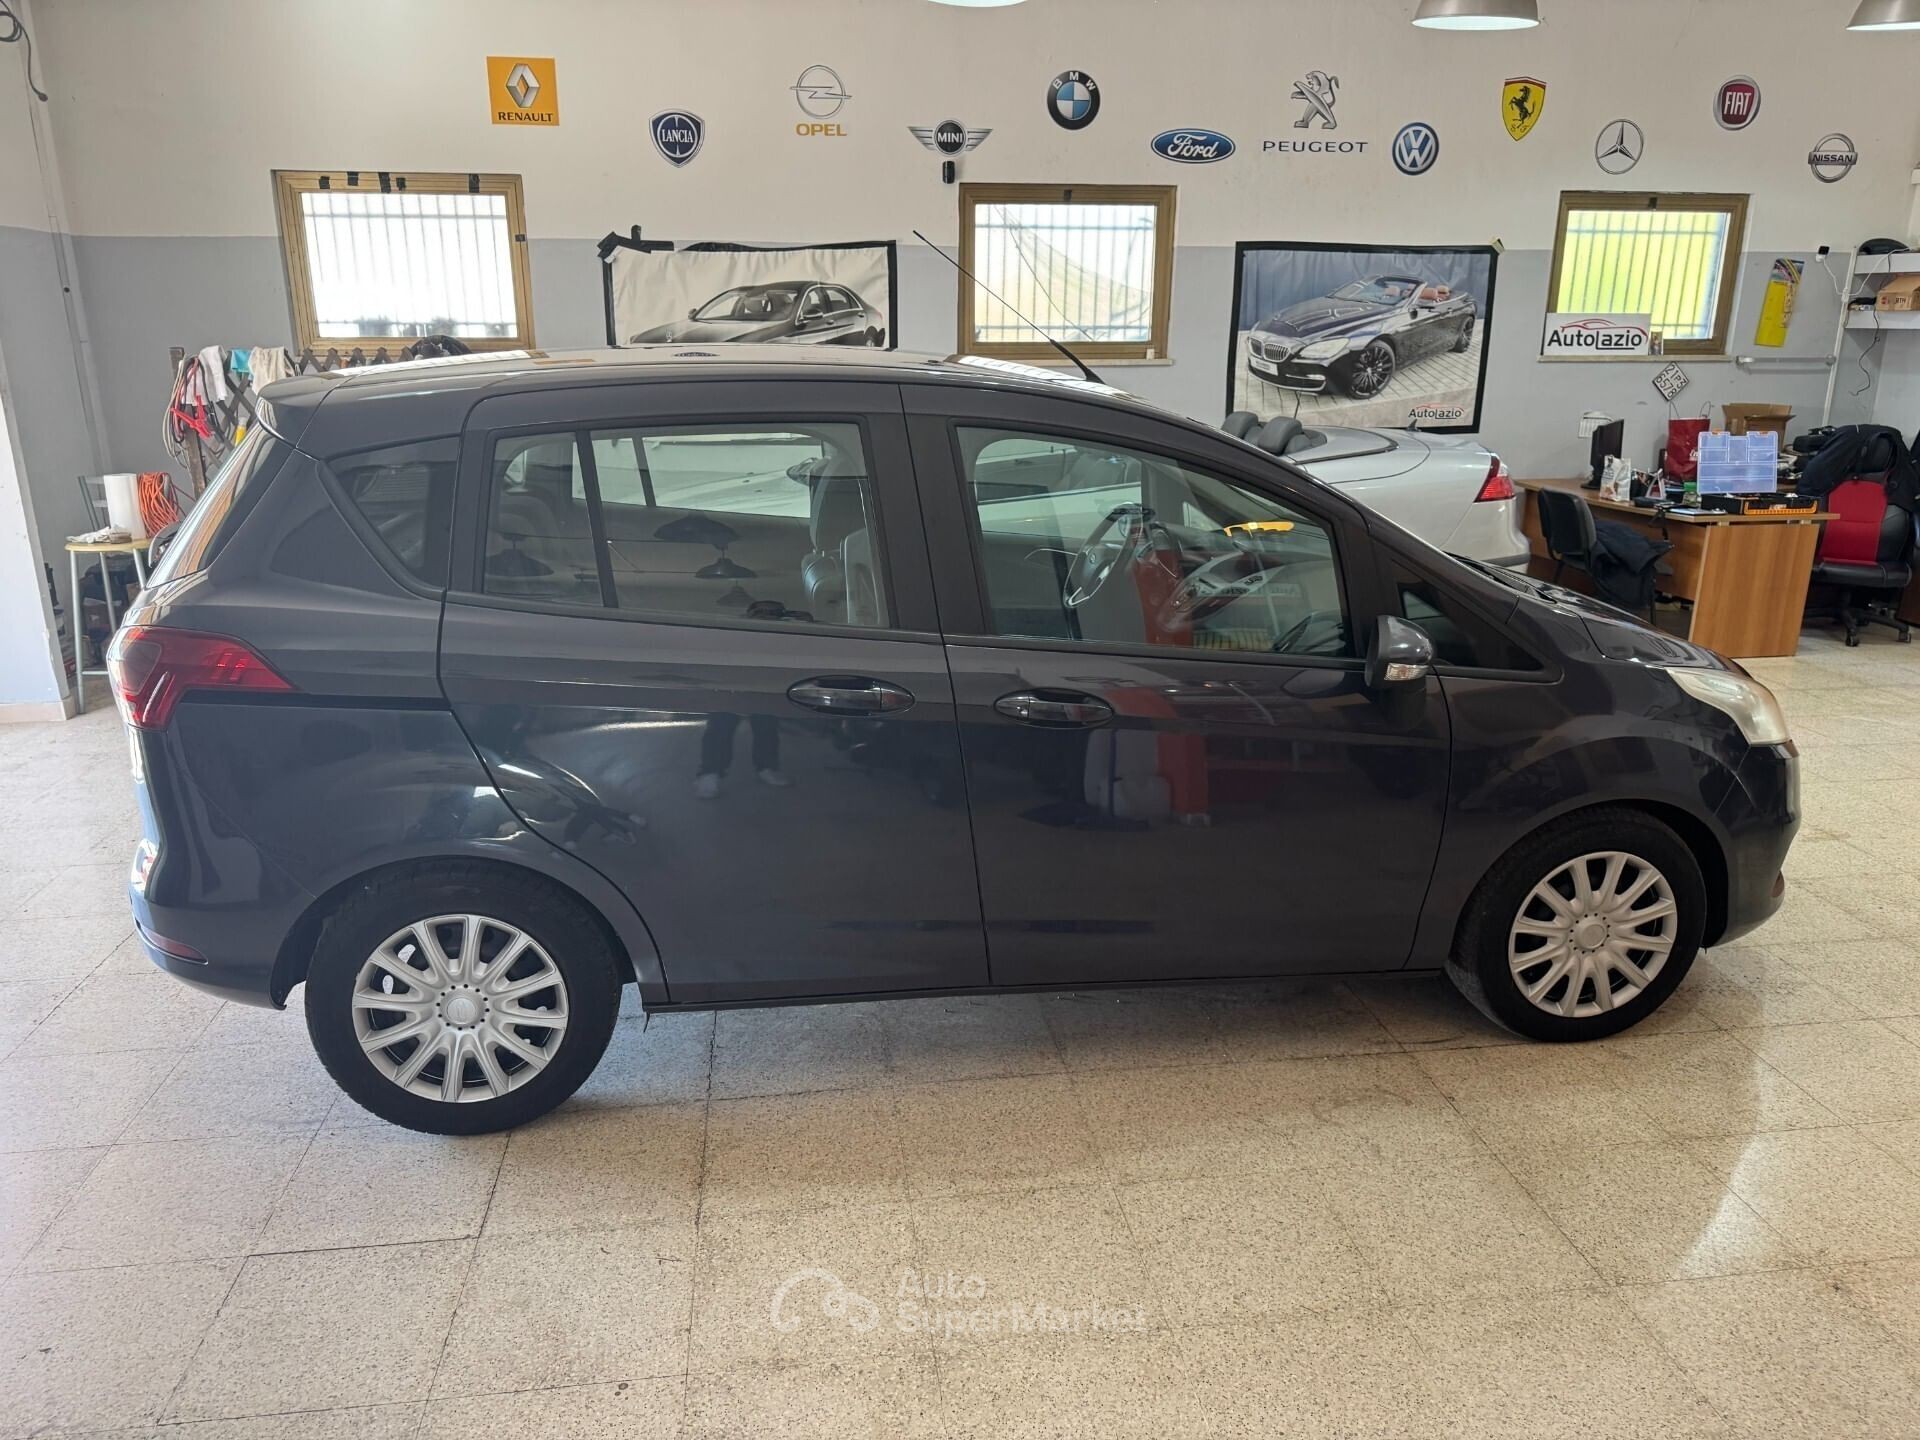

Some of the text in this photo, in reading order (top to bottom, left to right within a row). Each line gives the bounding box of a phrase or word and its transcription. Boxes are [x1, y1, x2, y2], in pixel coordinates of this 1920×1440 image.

[1052, 71, 1096, 91] BMW
[1723, 91, 1752, 116] FIAT
[498, 111, 553, 122] RENAULT
[661, 129, 694, 143] LANCIA
[796, 123, 848, 137] OPEL
[937, 132, 963, 143] MINI
[1167, 133, 1219, 158] Ford
[1263, 141, 1368, 153] PEUGEOT
[1813, 154, 1853, 163] NISSAN
